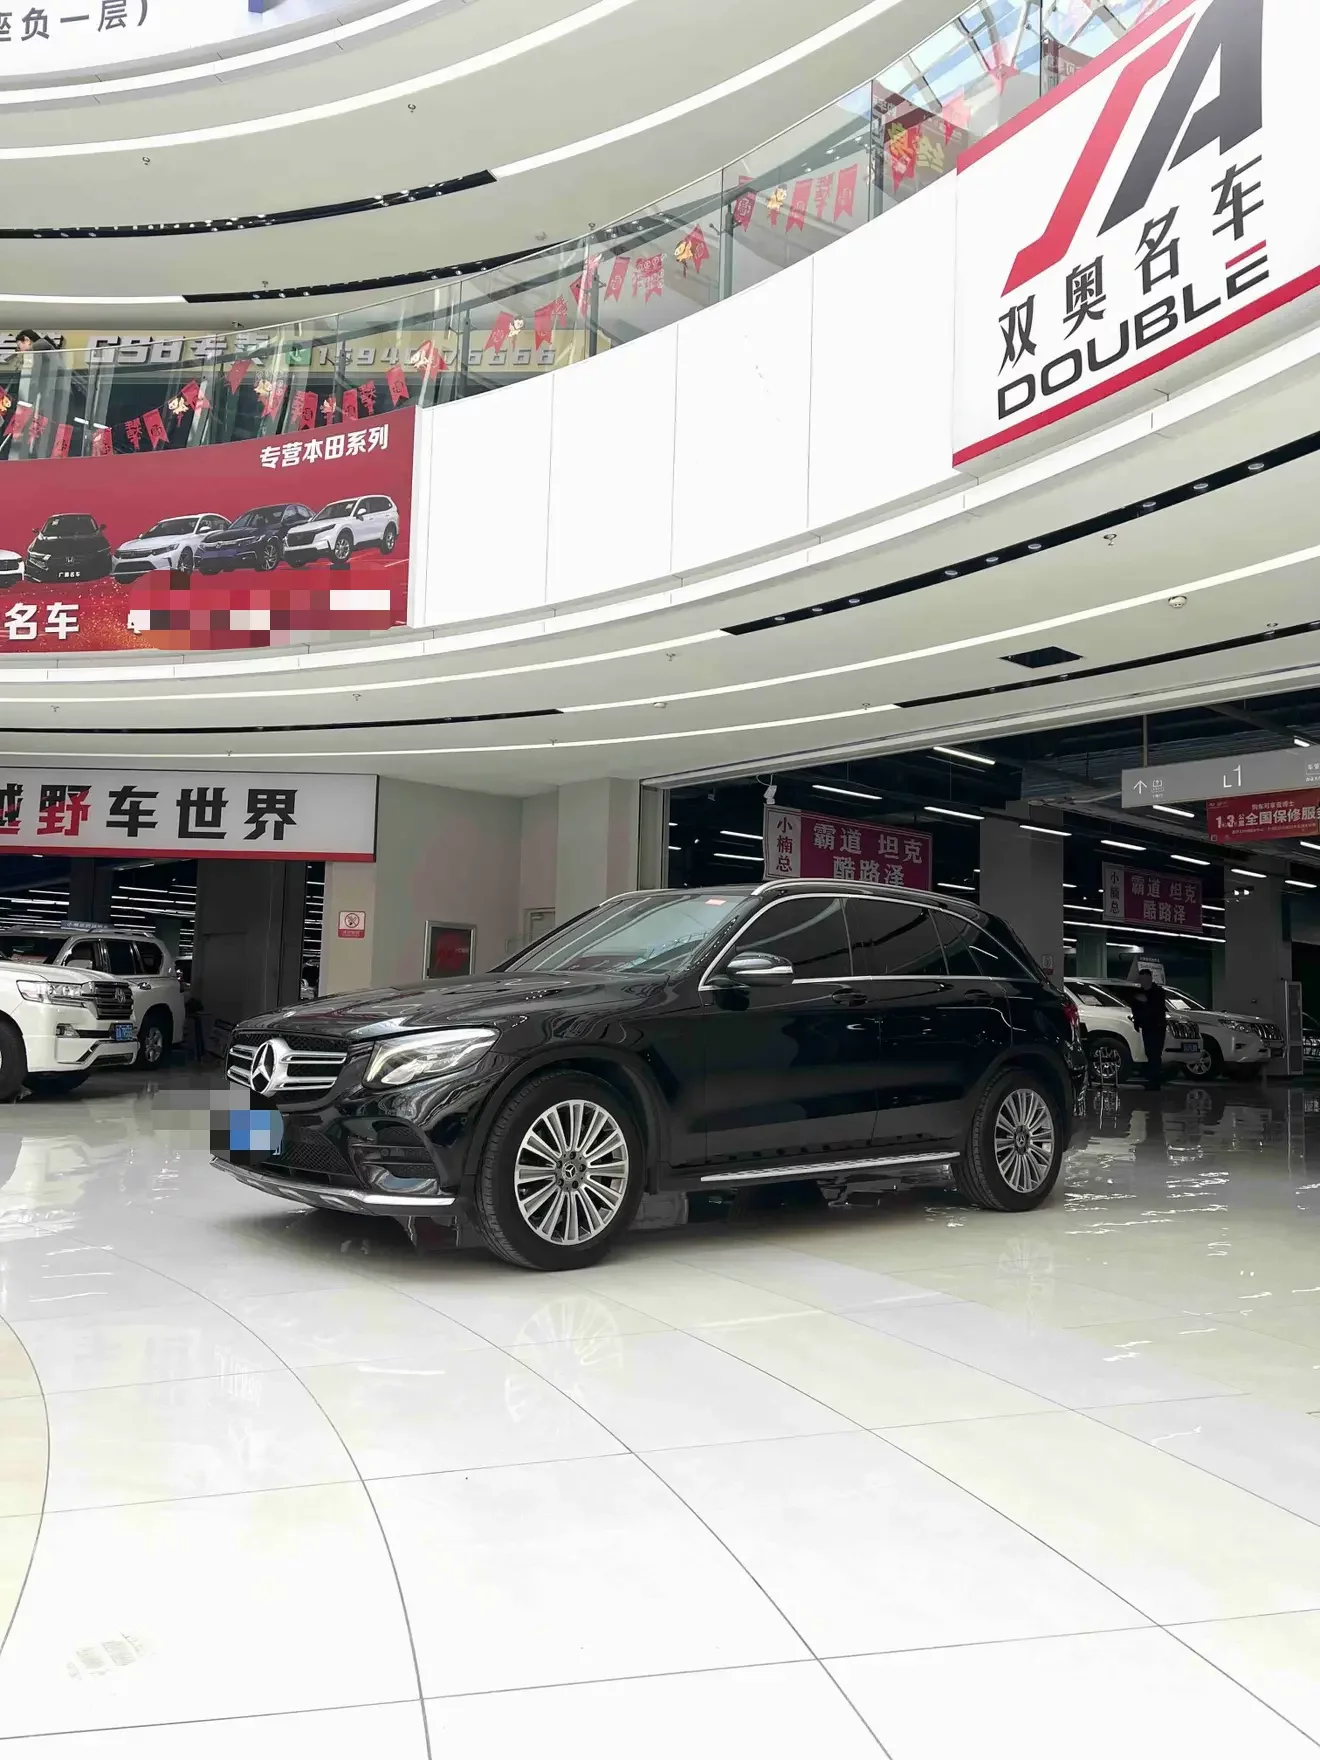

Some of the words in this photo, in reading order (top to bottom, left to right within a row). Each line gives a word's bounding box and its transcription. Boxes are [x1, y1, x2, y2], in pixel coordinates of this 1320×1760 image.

[997, 154, 1264, 376] 双奥名车
[997, 239, 1269, 420] DOUBLE
[259, 424, 389, 469] 专营本田系列
[4, 601, 80, 640] 名车
[1223, 765, 1243, 788] L1
[776, 817, 793, 873] 小楠总
[878, 834, 923, 864] 坦克
[833, 855, 904, 886] 酷路泽
